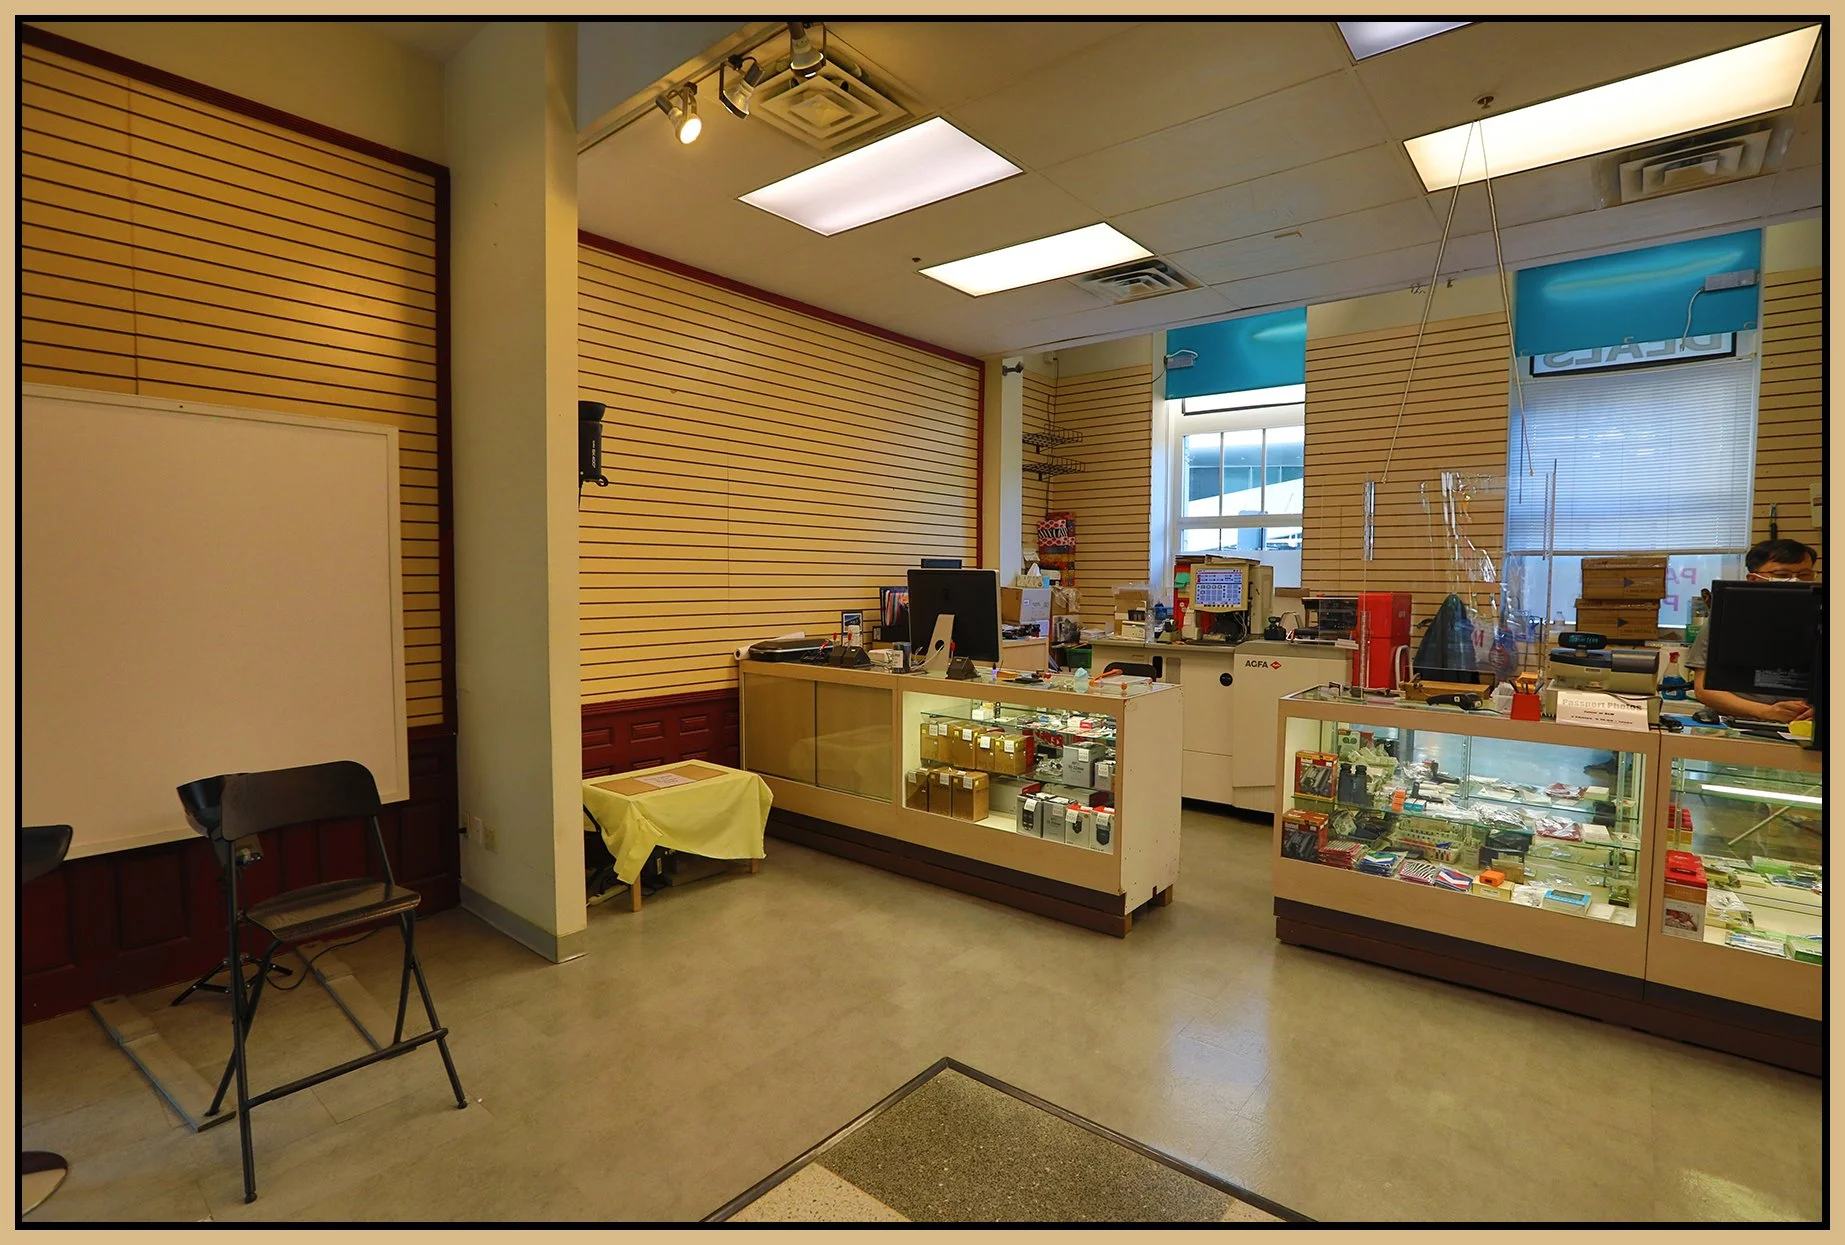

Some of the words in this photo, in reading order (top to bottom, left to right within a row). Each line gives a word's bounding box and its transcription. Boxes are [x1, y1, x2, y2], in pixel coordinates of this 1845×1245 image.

[1245, 660, 1268, 668] AGFA
[1562, 698, 1605, 709] Passport
[1607, 702, 1643, 711] Photos
